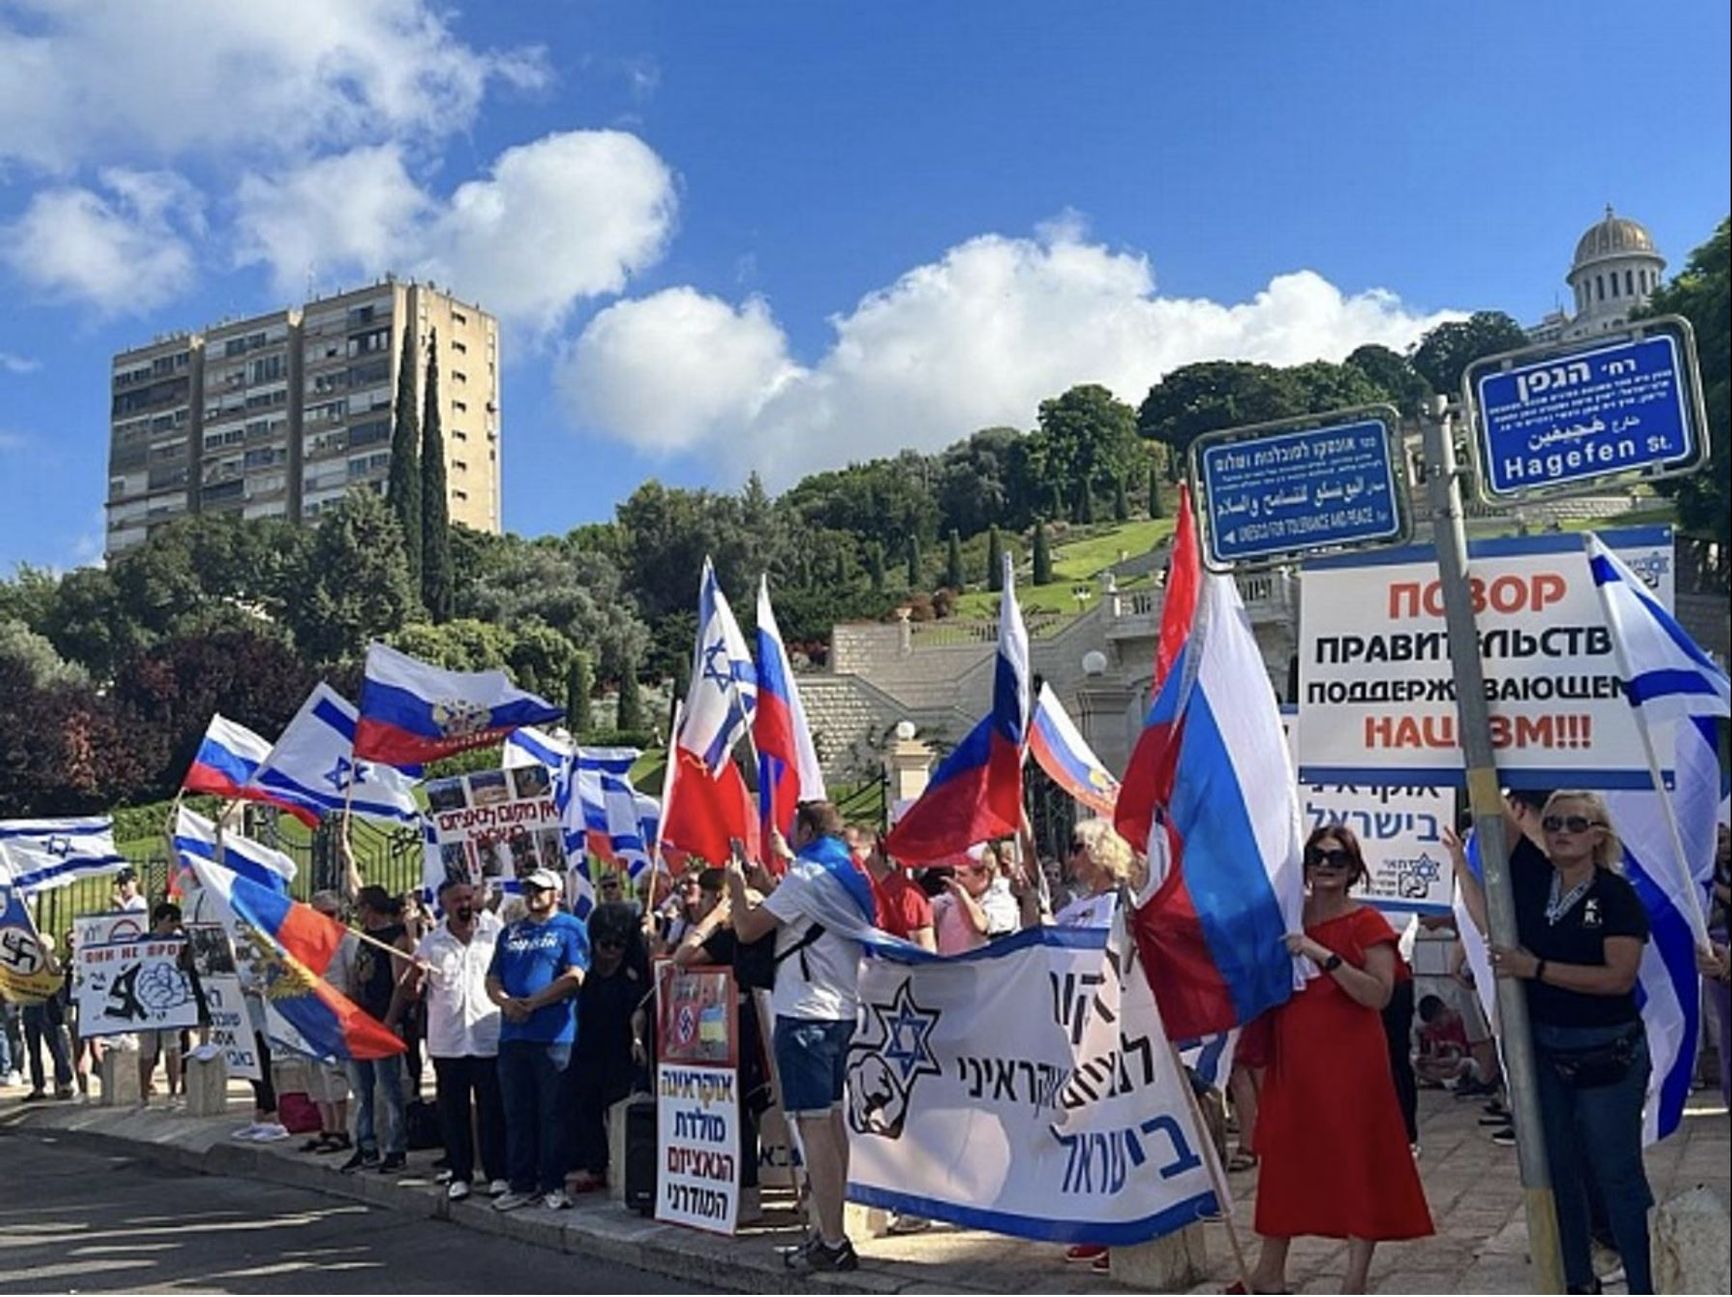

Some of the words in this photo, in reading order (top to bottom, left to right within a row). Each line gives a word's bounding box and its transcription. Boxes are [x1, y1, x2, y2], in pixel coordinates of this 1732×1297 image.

[1516, 361, 1592, 402] הגפן
[1503, 438, 1636, 480] Hagefen
[1646, 435, 1673, 453] St.
[1387, 574, 1568, 620] ПОЗОР
[1315, 626, 1614, 664] ПРАВИЛЬСТВ
[1307, 676, 1624, 704] ПОДДЕРЖВАЮЩЕ
[1364, 714, 1593, 750] НАЦЗМ!!!
[1305, 801, 1441, 842] בישראל
[661, 1070, 734, 1110] אוקראינה
[674, 1105, 727, 1144] מולדת
[667, 1145, 735, 1183] הנאציזם
[1049, 1114, 1202, 1195] בישראל
[667, 1182, 729, 1221] המודרני
